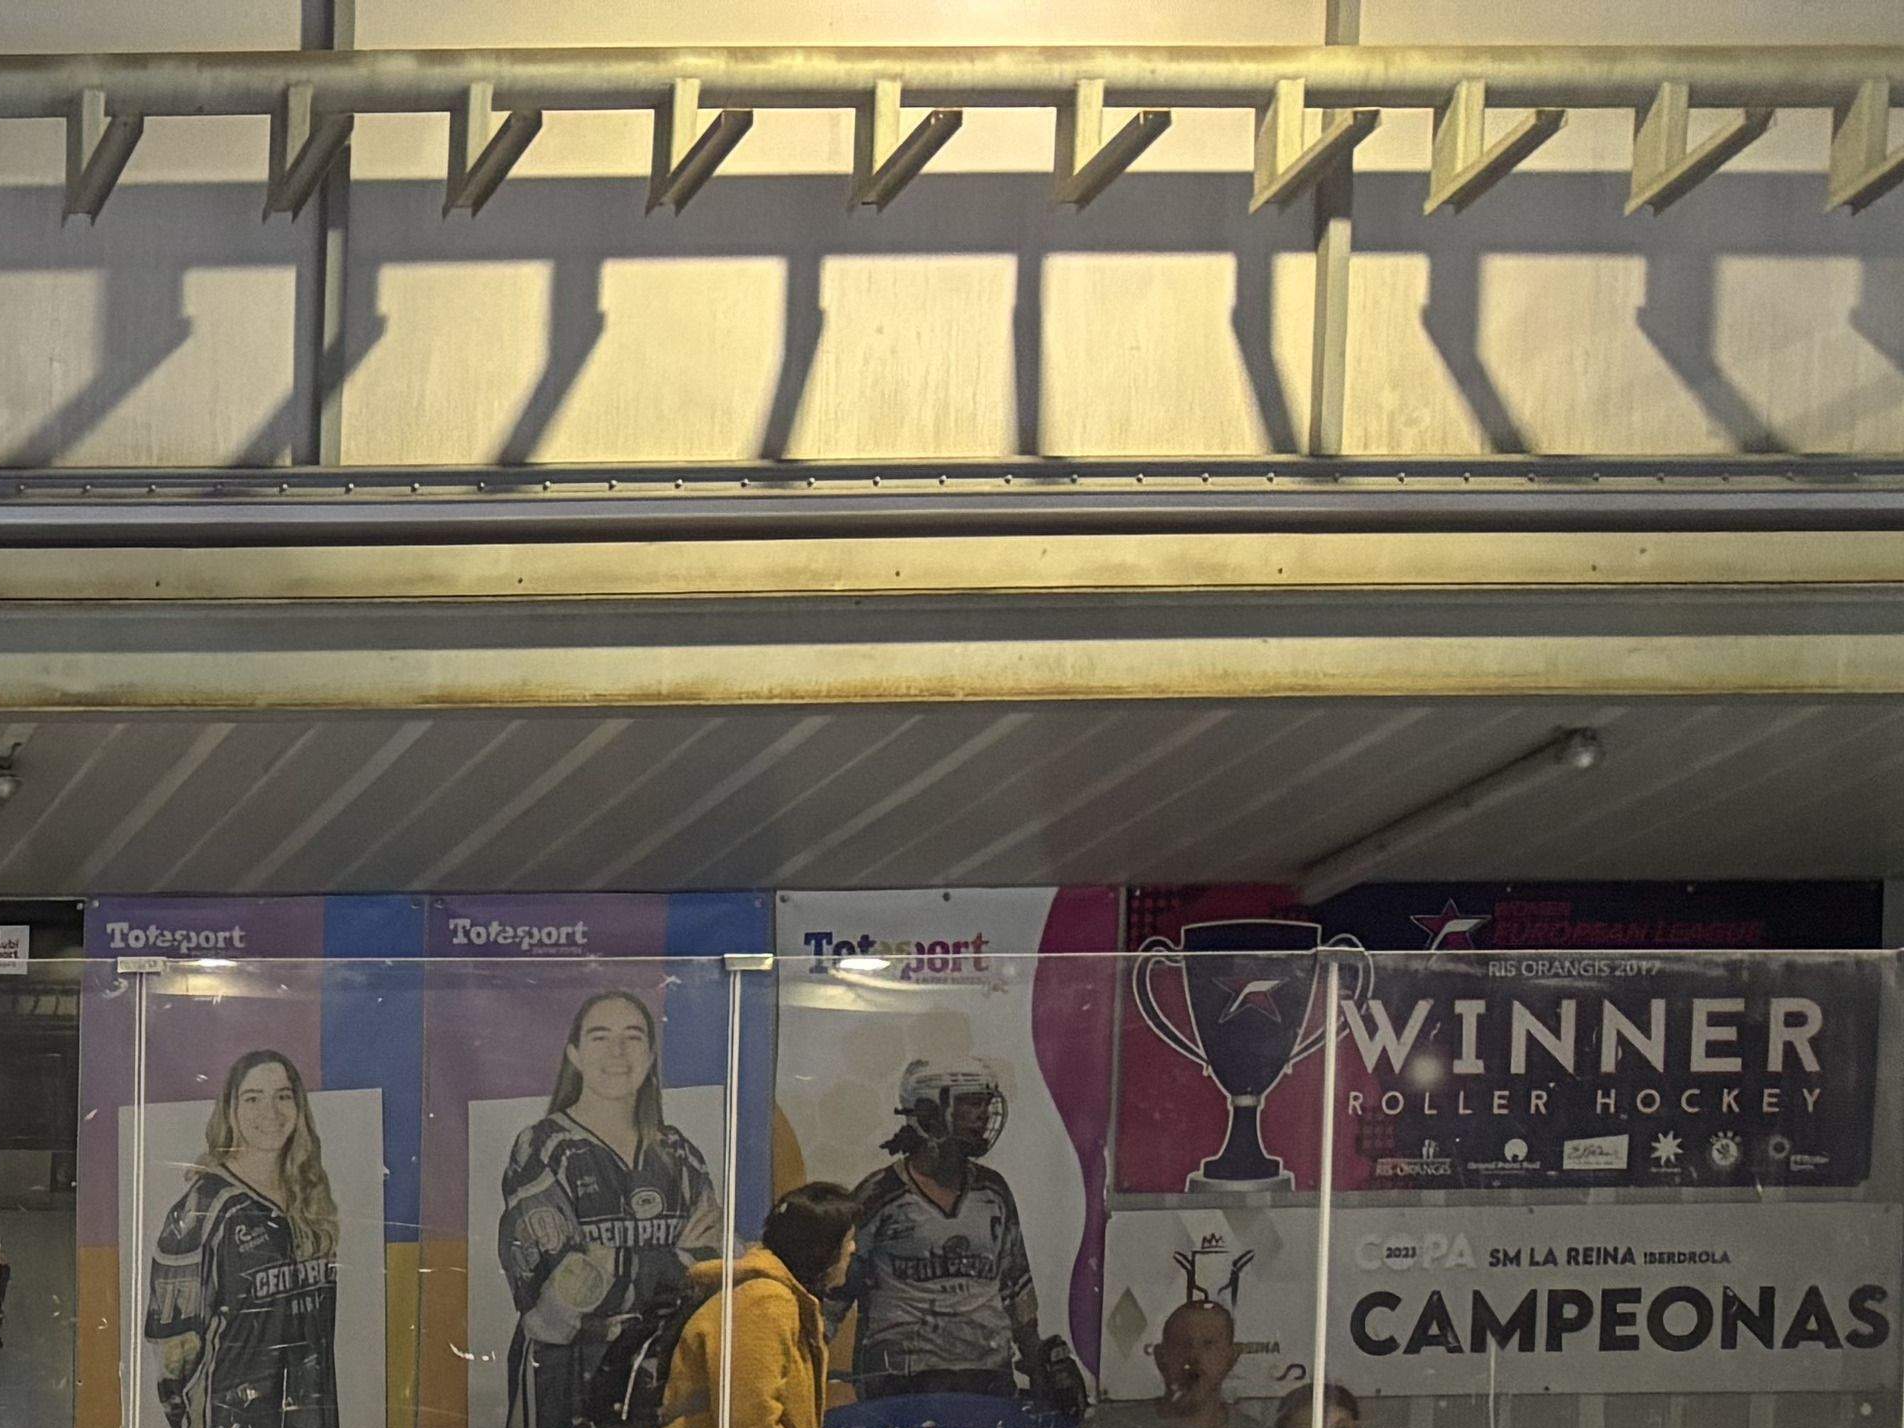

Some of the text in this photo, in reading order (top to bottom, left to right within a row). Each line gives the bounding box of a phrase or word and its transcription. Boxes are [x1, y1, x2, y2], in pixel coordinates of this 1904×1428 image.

[1488, 960, 1516, 977] RIS
[1521, 959, 1611, 977] ORANGIS
[1338, 996, 1825, 1076] WINNER
[1348, 1087, 1824, 1117] ROLLER HOCKEY
[1488, 1245, 1732, 1268] SM LA REINA IBERDROLA
[1349, 1284, 1892, 1357] CAMPEONAS
